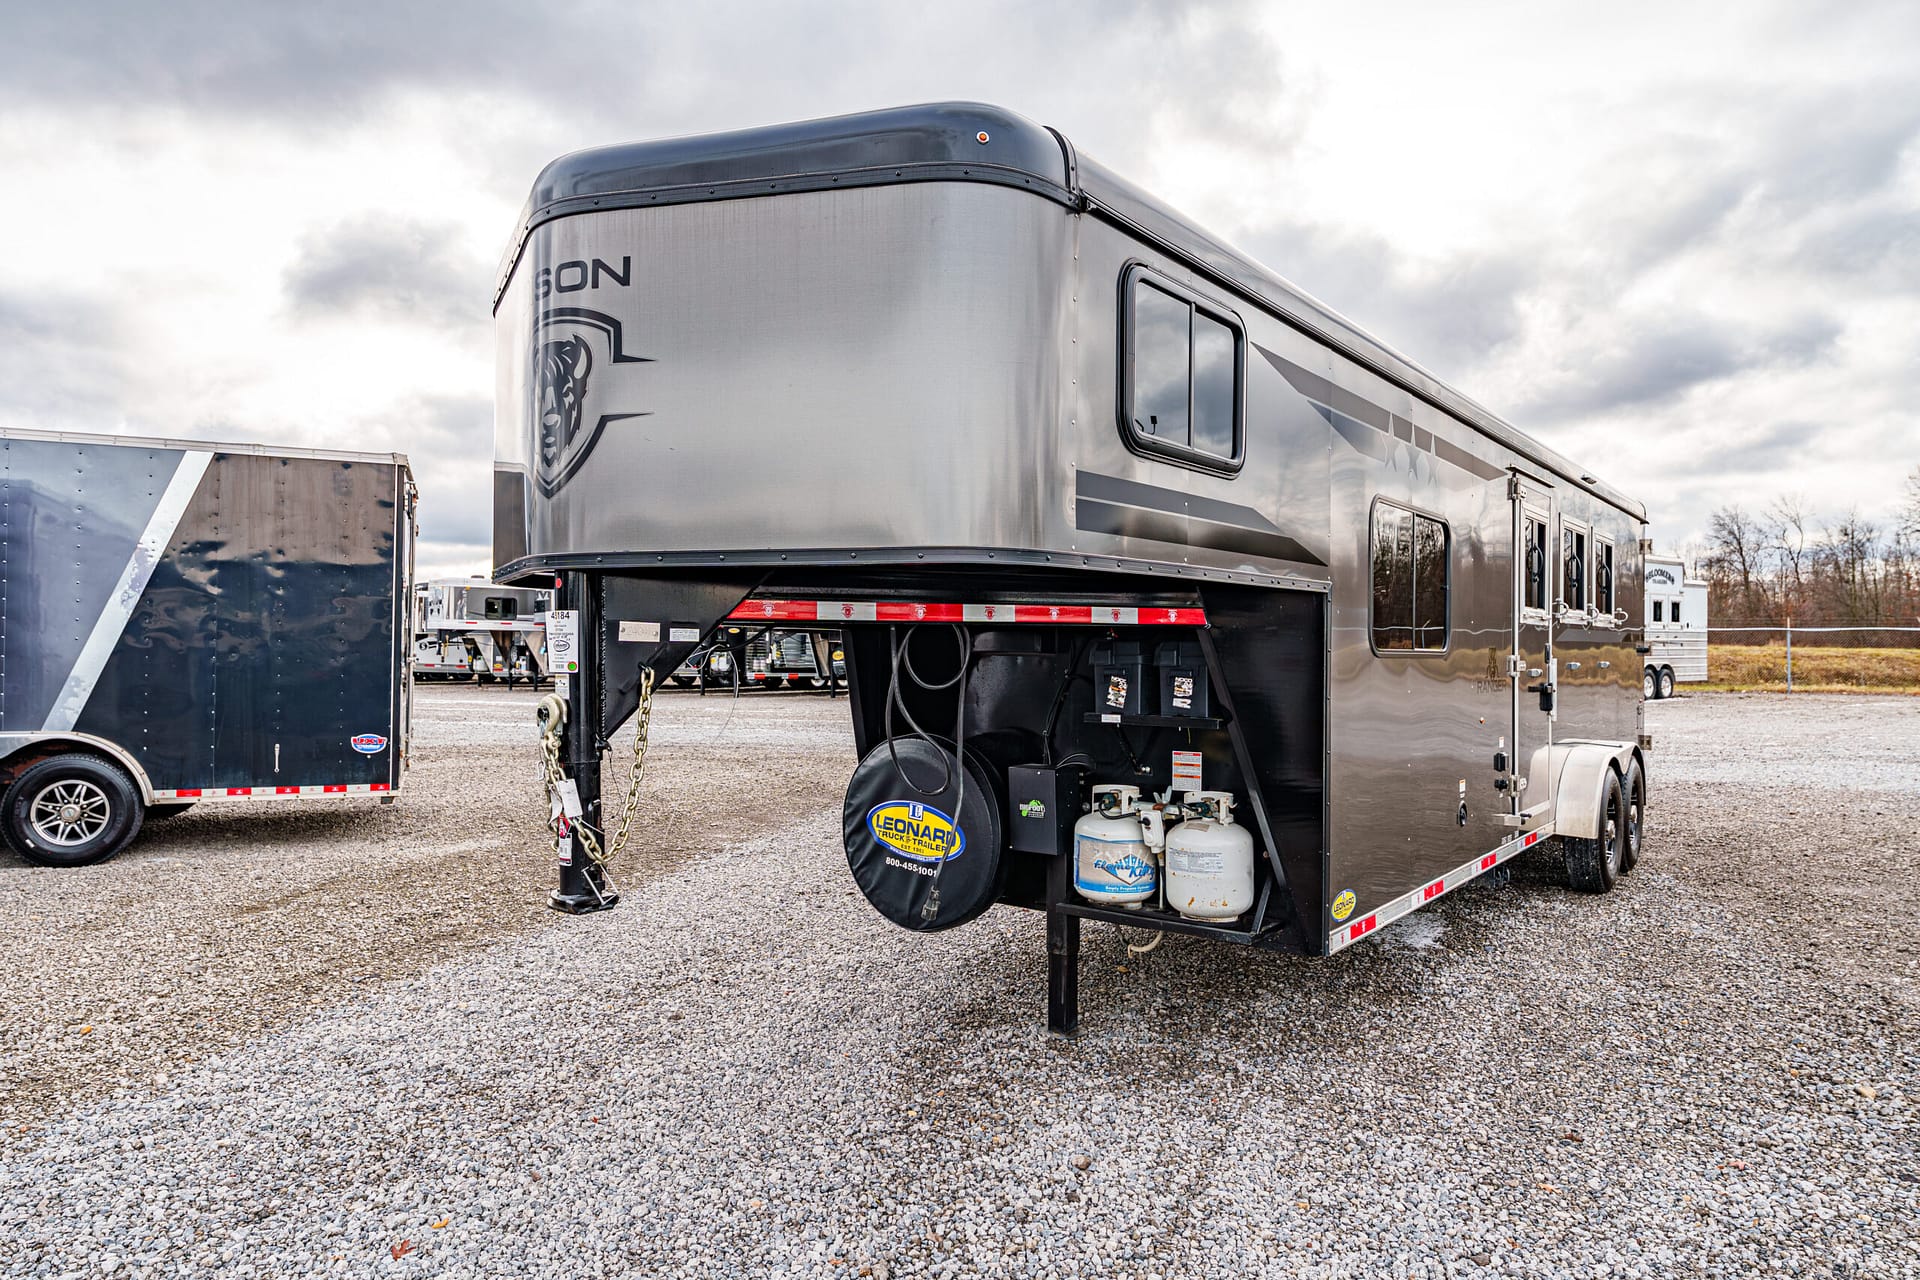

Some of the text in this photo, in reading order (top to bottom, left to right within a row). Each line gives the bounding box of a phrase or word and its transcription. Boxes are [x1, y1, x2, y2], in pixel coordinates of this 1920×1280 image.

[876, 813, 957, 847] LEONARD
[878, 829, 905, 842] TRUCK
[885, 856, 937, 877] 800-455-1001
